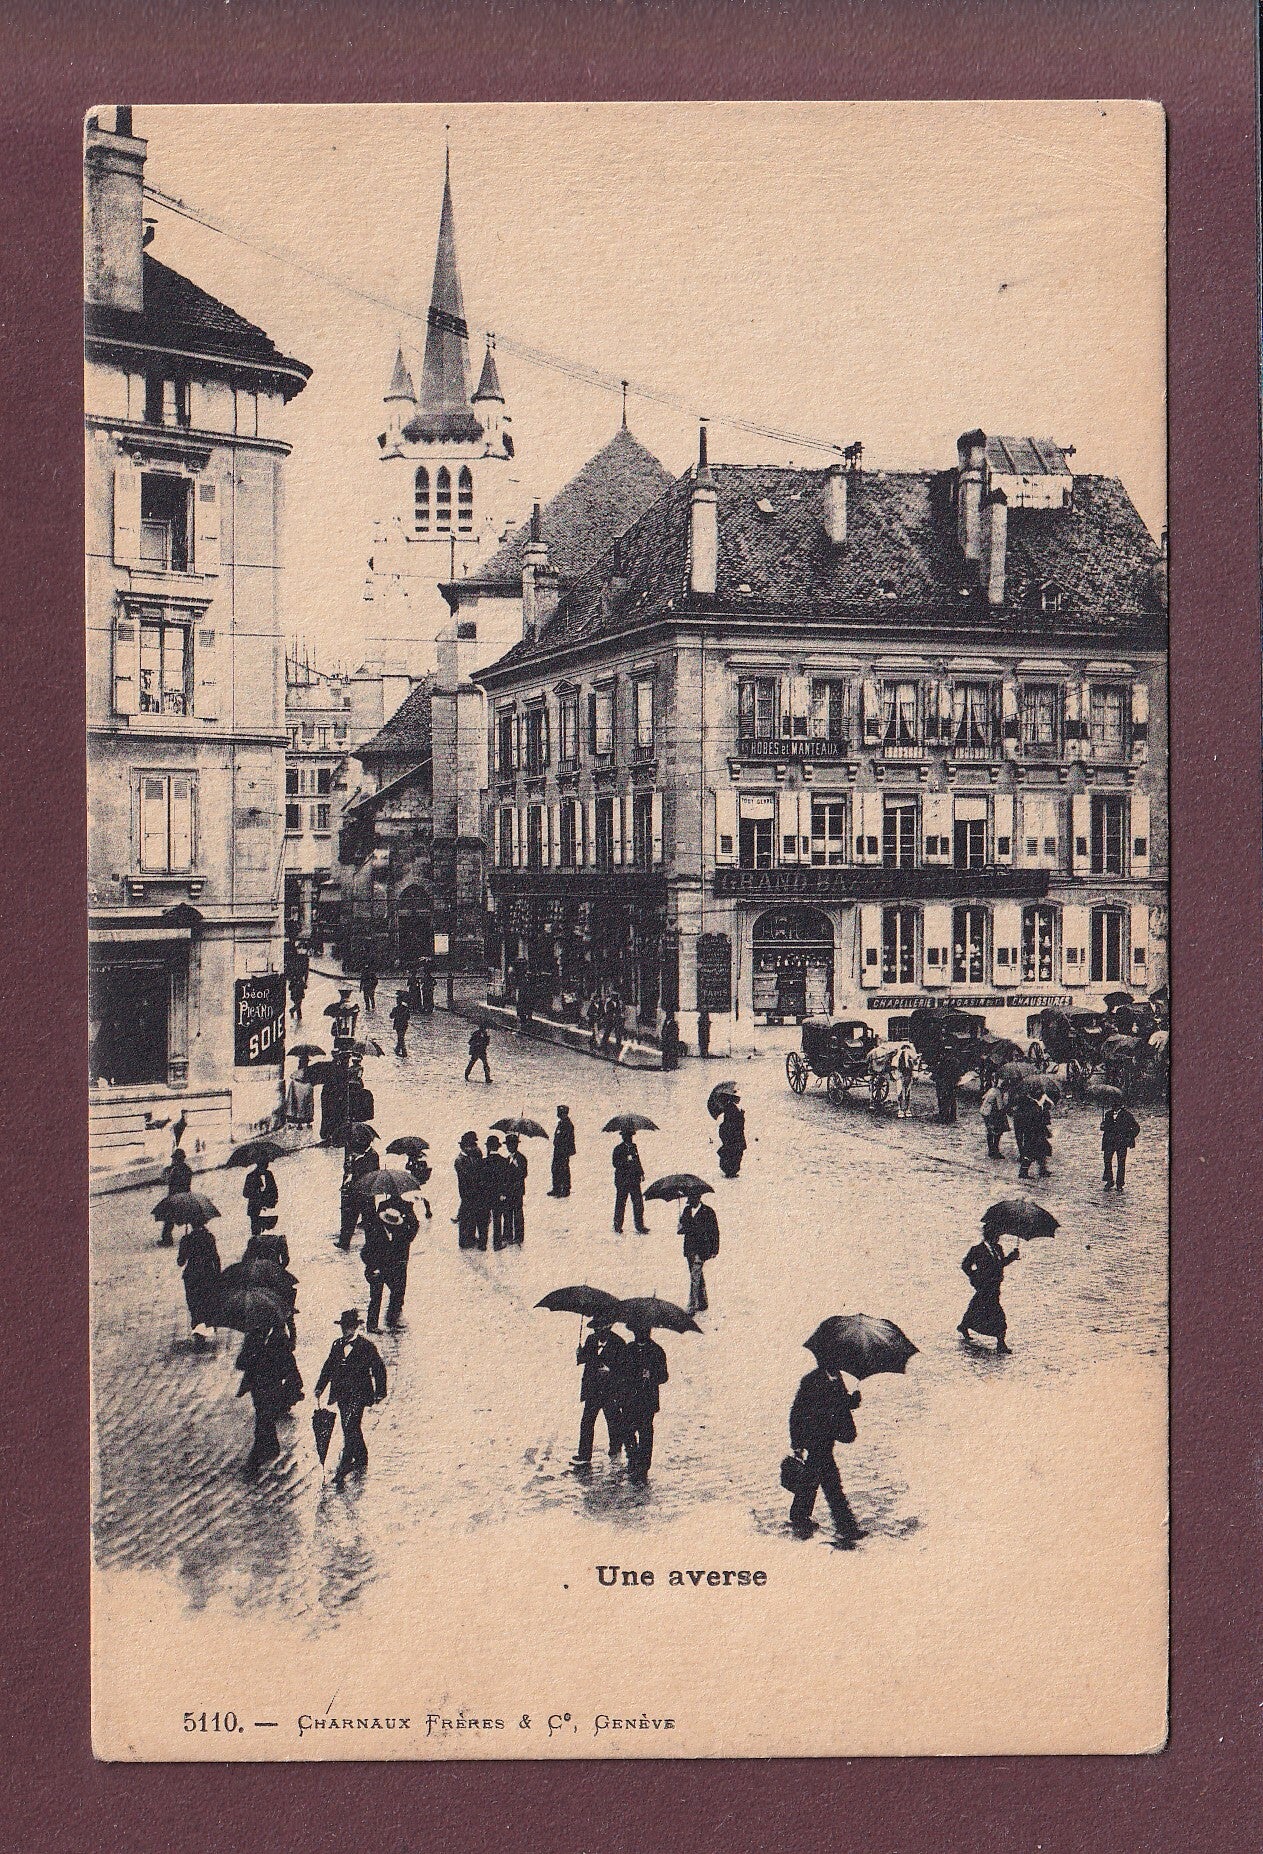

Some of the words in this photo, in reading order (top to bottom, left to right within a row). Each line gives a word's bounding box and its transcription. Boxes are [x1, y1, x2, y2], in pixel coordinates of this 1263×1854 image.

[750, 741, 780, 755] ROBES
[791, 742, 839, 756] MANTEAUX
[721, 872, 808, 892] GRAND
[873, 998, 933, 1008] CHAPELLERIE
